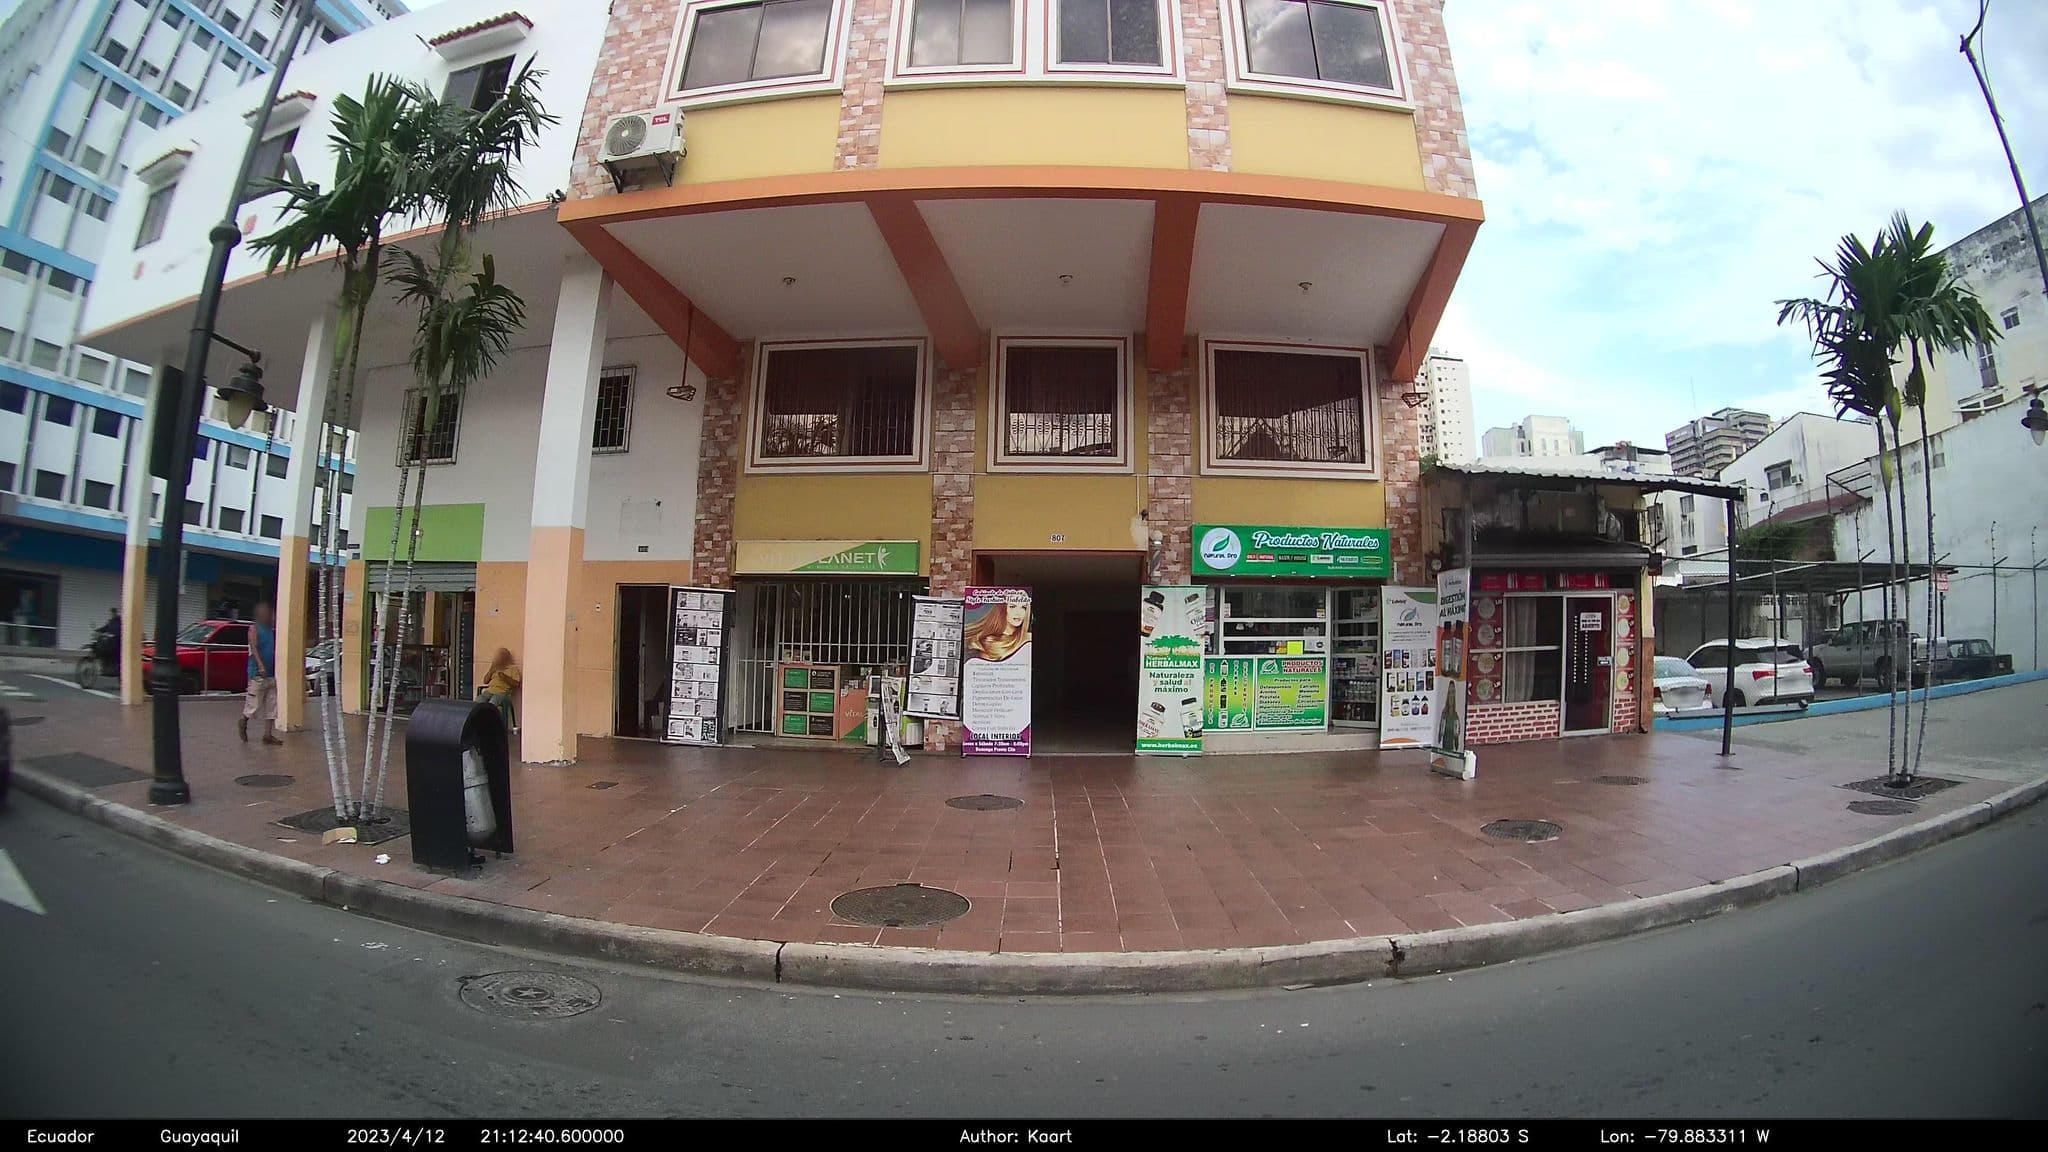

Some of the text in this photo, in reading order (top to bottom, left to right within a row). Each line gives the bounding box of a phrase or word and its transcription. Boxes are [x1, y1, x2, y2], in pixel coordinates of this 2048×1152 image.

[1051, 534, 1064, 542] 807
[1252, 530, 1380, 550] Productos Naturales
[966, 596, 982, 604] Style
[1439, 608, 1446, 618] AL
[1146, 660, 1198, 668] HERBALMAX
